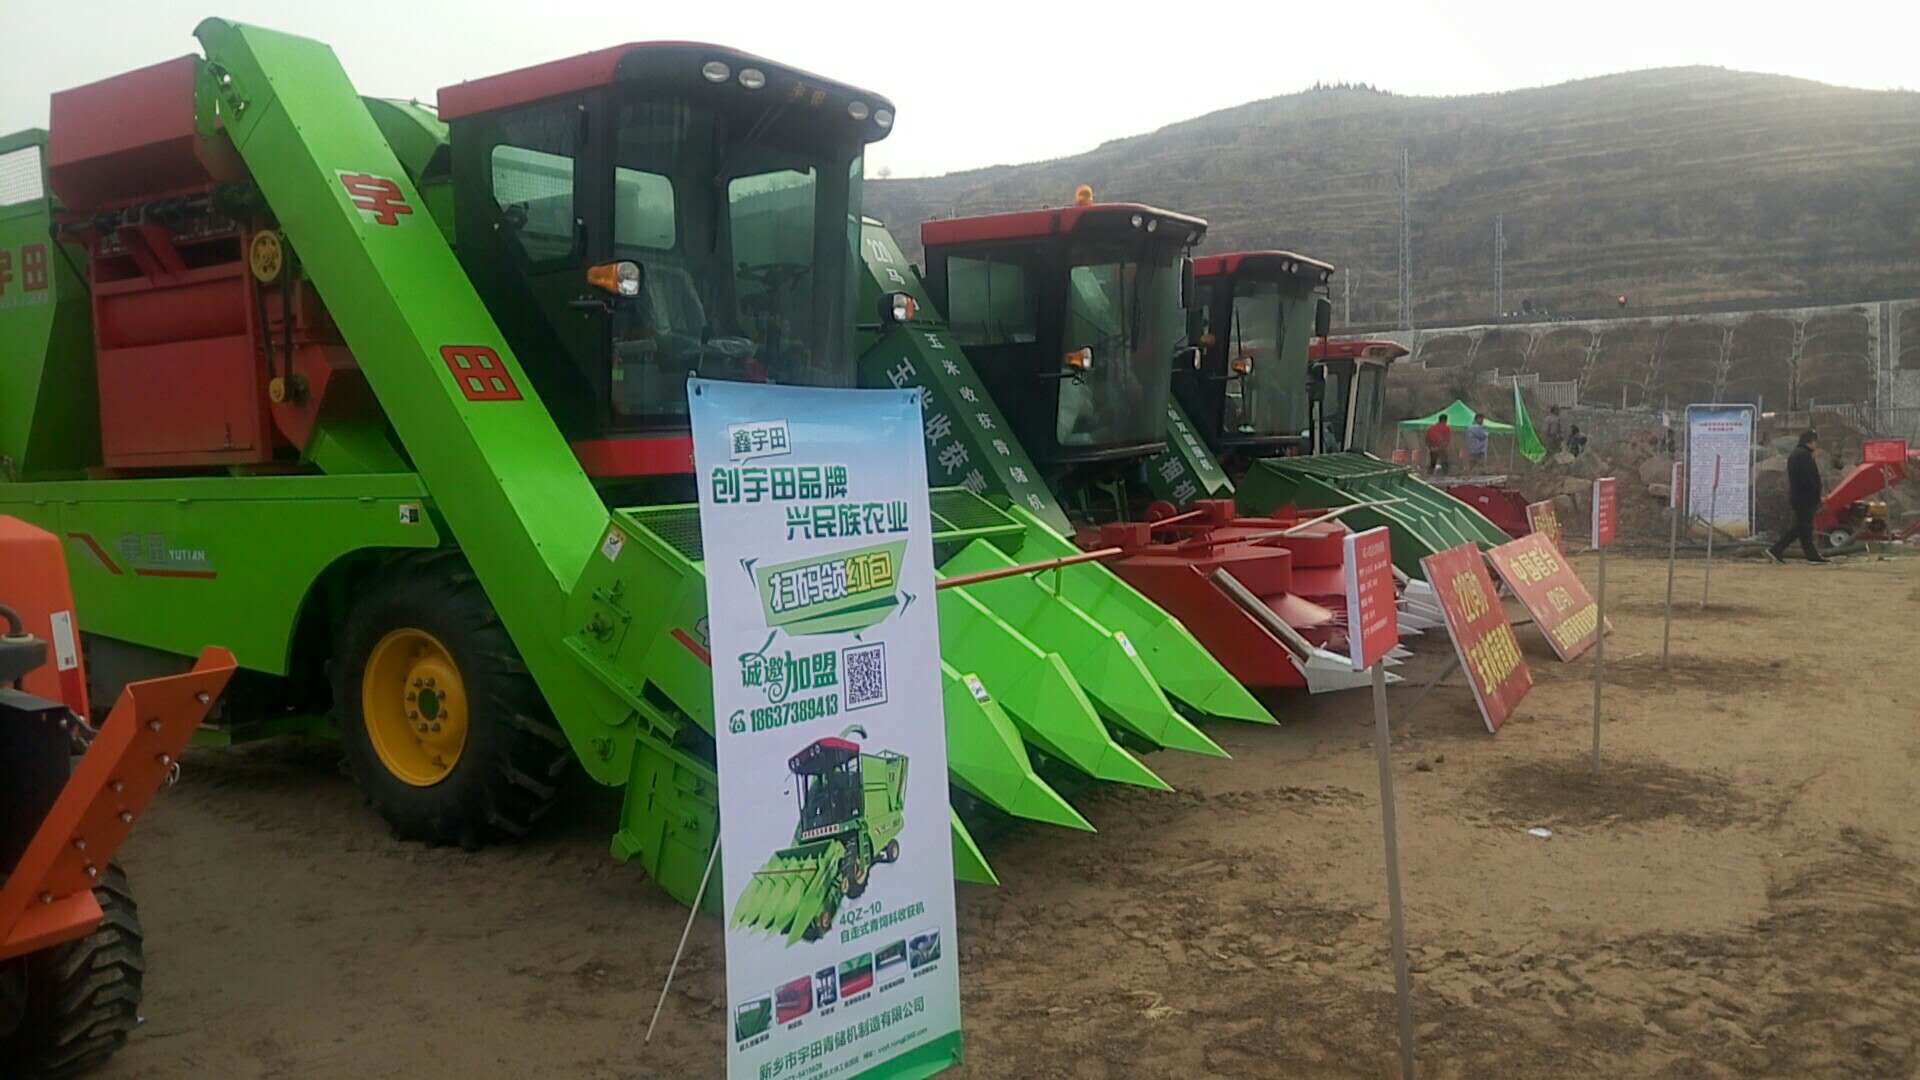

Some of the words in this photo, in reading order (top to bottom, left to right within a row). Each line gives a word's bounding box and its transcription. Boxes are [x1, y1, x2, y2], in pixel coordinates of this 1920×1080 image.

[733, 427, 786, 453] 鑫宇田
[711, 465, 848, 504] 创宇田品牌
[786, 501, 909, 541] 兴民族农业
[168, 549, 206, 561] YUTIAN
[769, 550, 894, 614] 扫码领红包
[738, 648, 839, 698] 诚邀加盟
[750, 693, 839, 732] 18637389413
[839, 901, 882, 926] 4QZ-10
